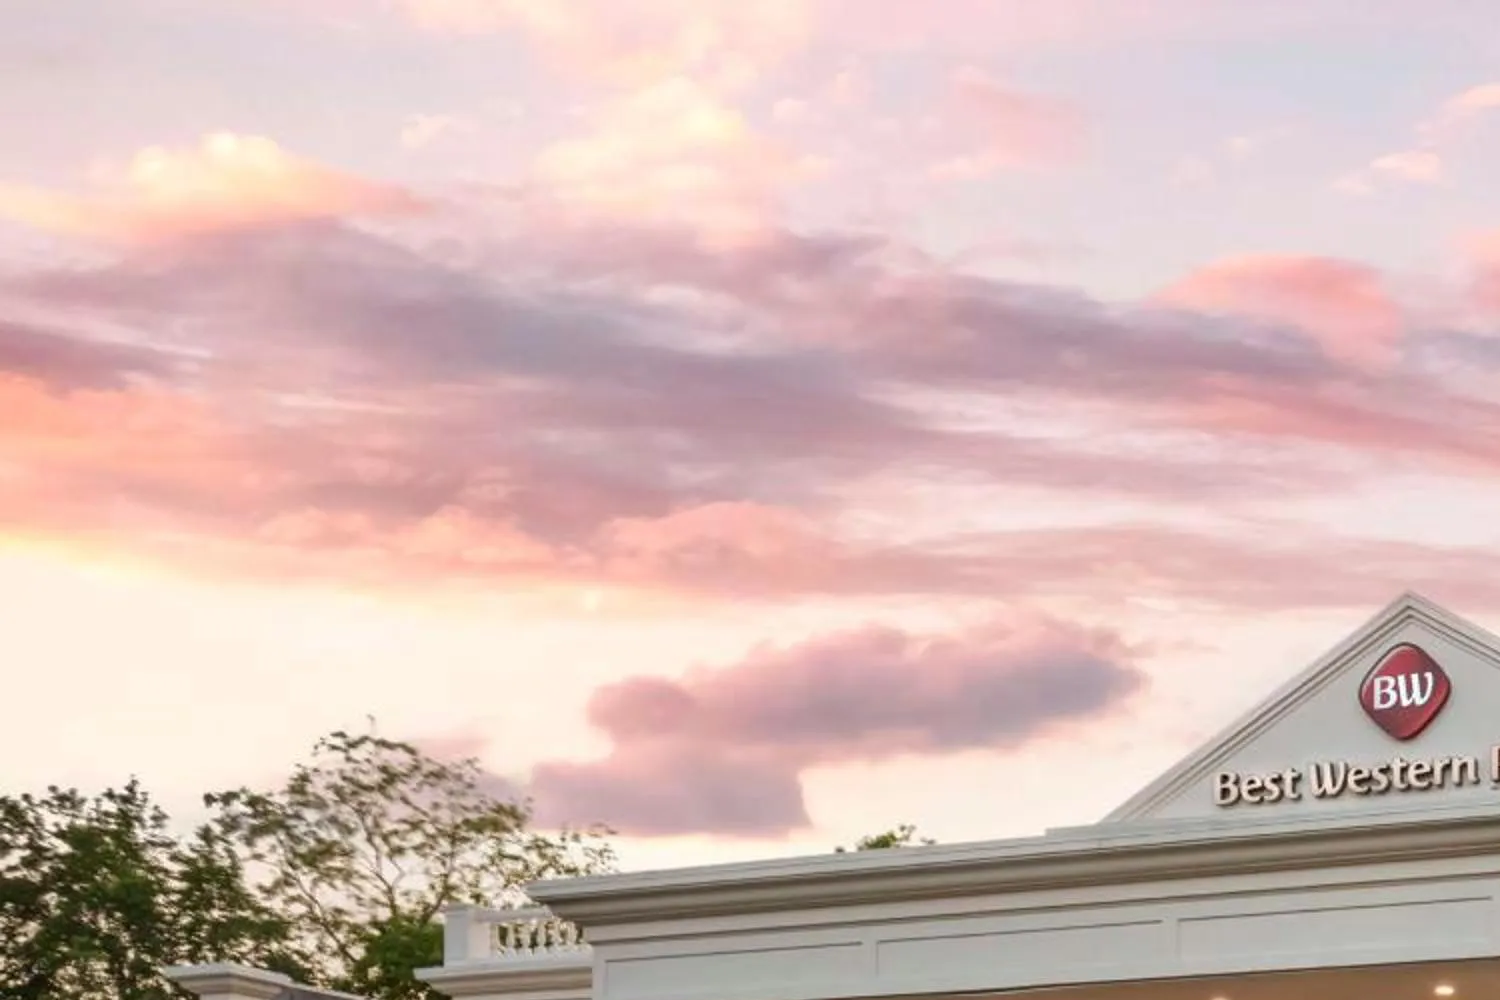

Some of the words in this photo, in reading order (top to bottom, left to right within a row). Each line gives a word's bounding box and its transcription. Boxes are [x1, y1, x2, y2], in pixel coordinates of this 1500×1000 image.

[1373, 671, 1434, 710] BW
[1214, 771, 1301, 806] Best
[1309, 754, 1480, 798] Western
